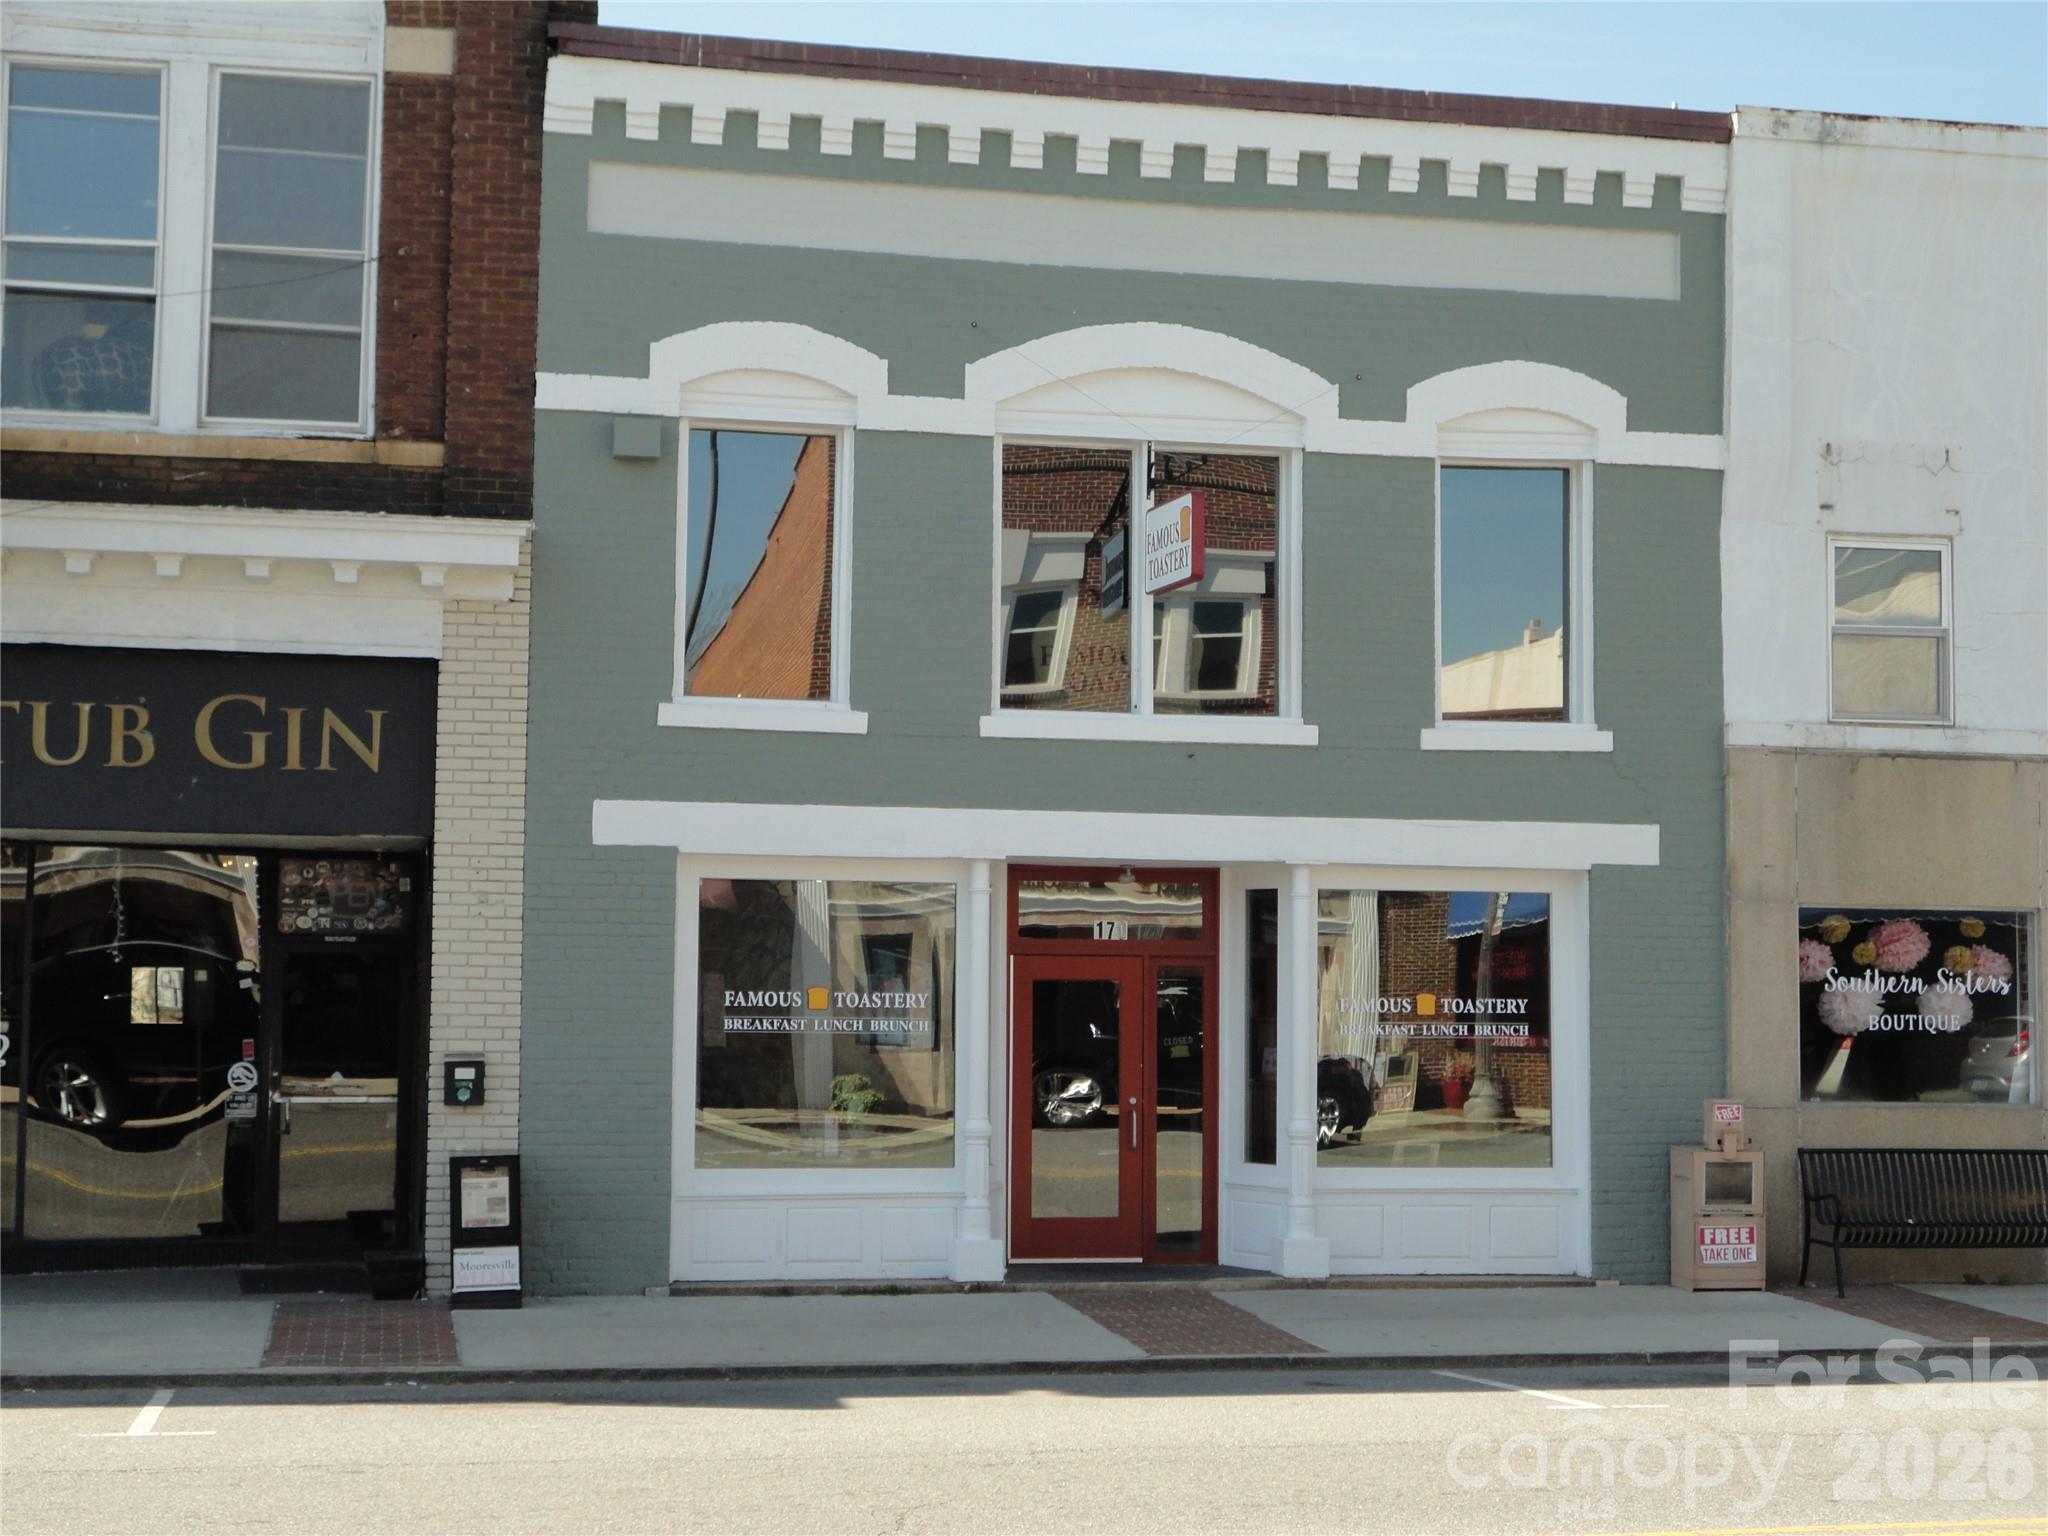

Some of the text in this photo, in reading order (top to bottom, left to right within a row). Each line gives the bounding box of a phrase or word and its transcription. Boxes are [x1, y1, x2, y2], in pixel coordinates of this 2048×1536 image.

[1147, 521, 1181, 555] FAMOUS
[1148, 545, 1190, 581] TOASTERY
[194, 693, 390, 774] GIN
[1824, 966, 2012, 996] Southern Sisters
[724, 991, 929, 1009] FAMOUS TOASTERY
[1339, 998, 1529, 1014] FAMOUS TOASTERY
[724, 1018, 929, 1032] BREAKFAST LUNCH BRUNCH
[1339, 1024, 1529, 1036] BREAKFAST LUNCH BRUNCH
[1868, 1014, 1961, 1034] BOUTIQUE
[1715, 1107, 1741, 1120] FREE
[1704, 1228, 1751, 1245] FREE
[1703, 1247, 1753, 1261] TAKE ONE
